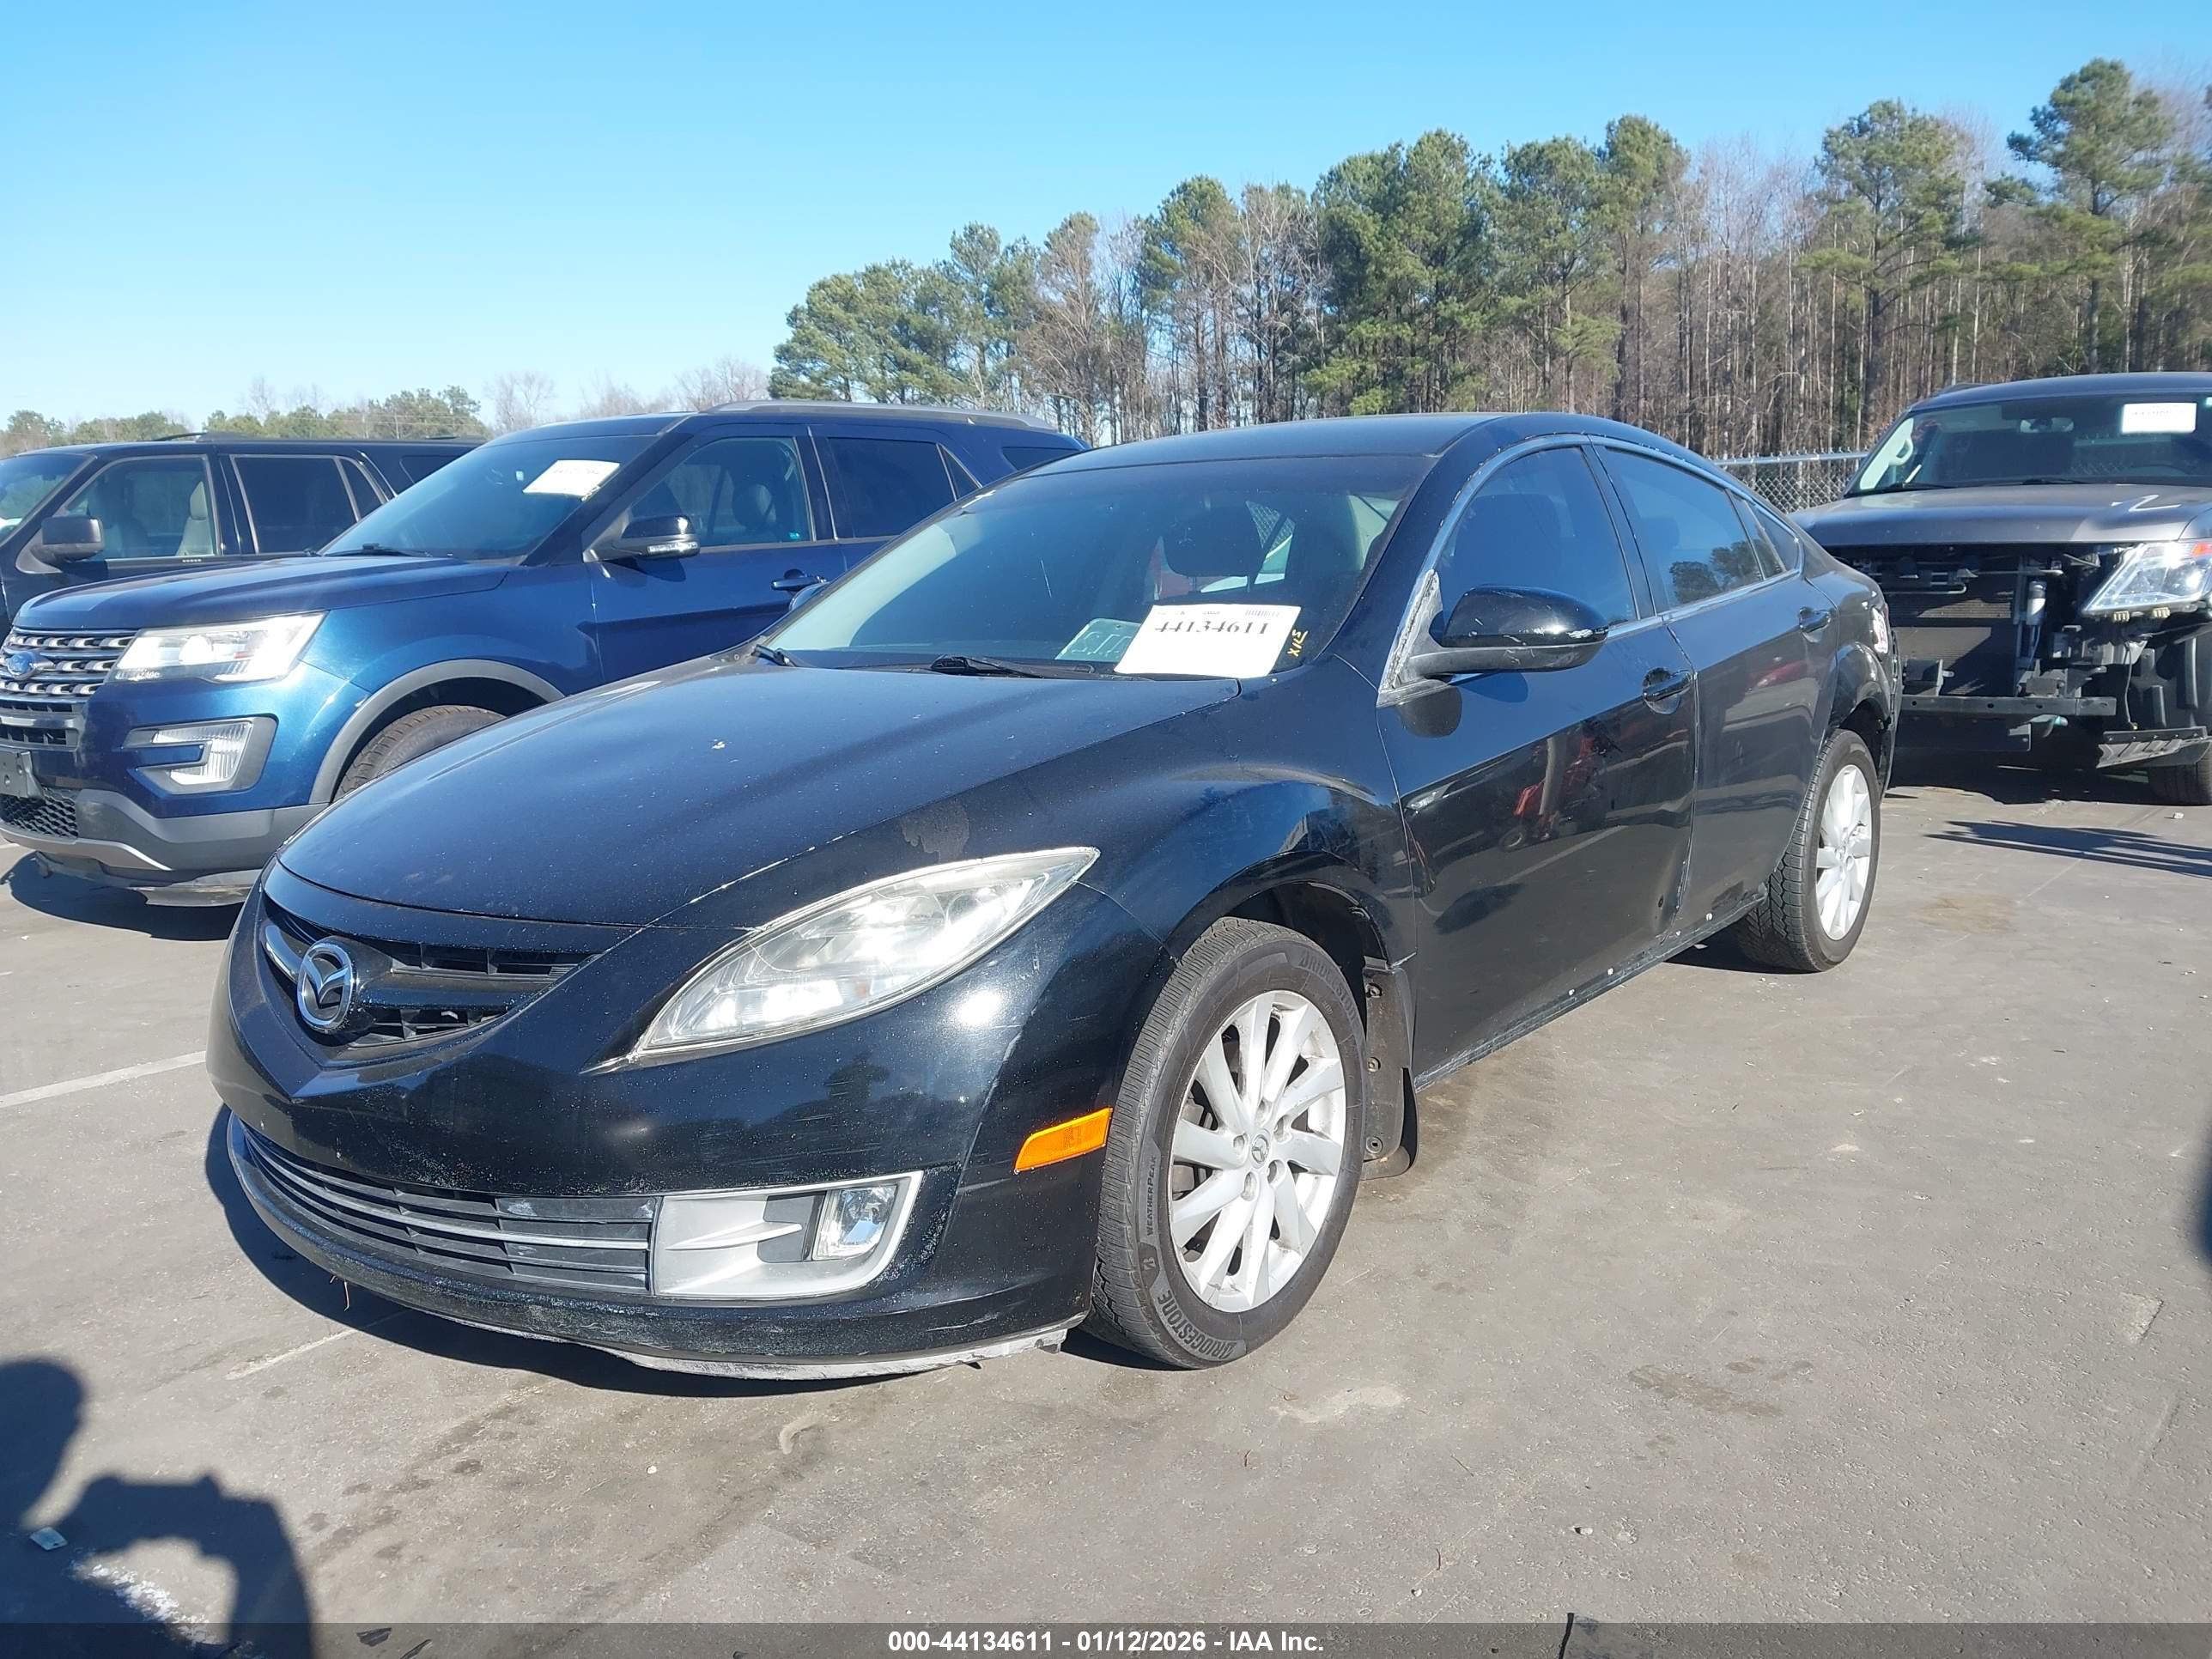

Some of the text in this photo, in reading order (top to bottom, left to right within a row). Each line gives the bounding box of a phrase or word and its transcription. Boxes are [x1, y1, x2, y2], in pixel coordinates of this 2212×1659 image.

[1154, 619, 1269, 635] 44134611
[1298, 949, 1361, 1029] BRIDSTON
[1157, 1289, 1237, 1360] BRIDGESTONE
